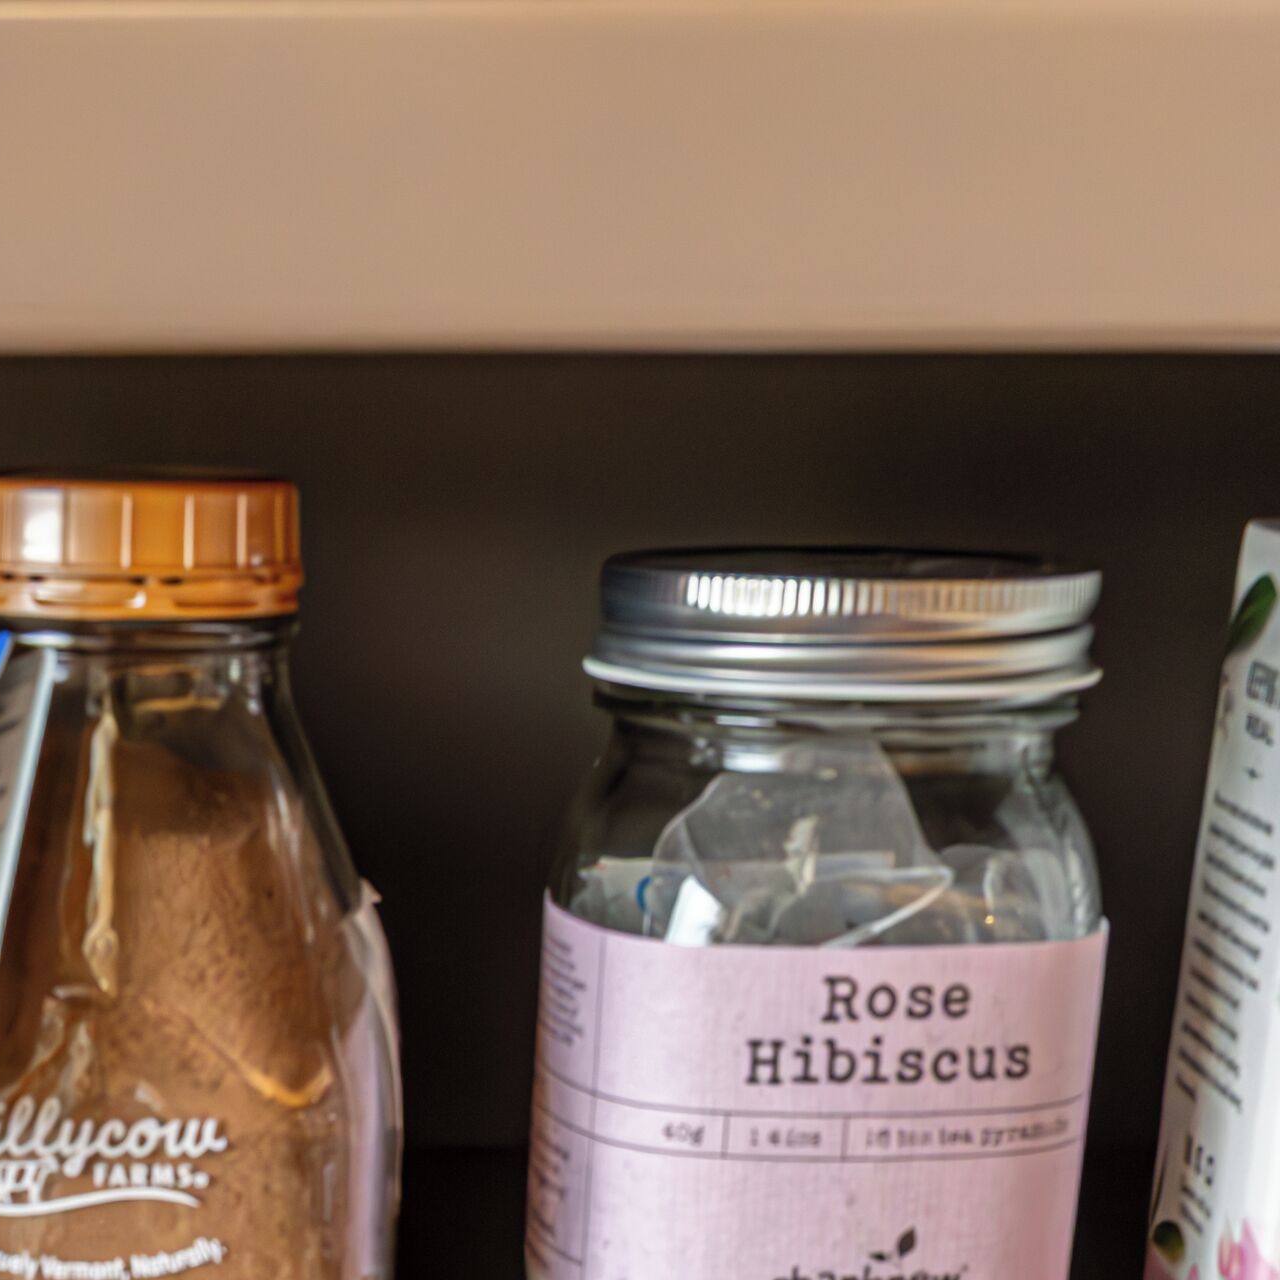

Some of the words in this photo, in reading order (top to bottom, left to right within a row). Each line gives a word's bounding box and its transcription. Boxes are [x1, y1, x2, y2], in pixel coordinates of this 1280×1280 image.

[820, 975, 972, 1024] Rose
[745, 1037, 1032, 1086] Hibiscus
[939, 1124, 973, 1147] tea
